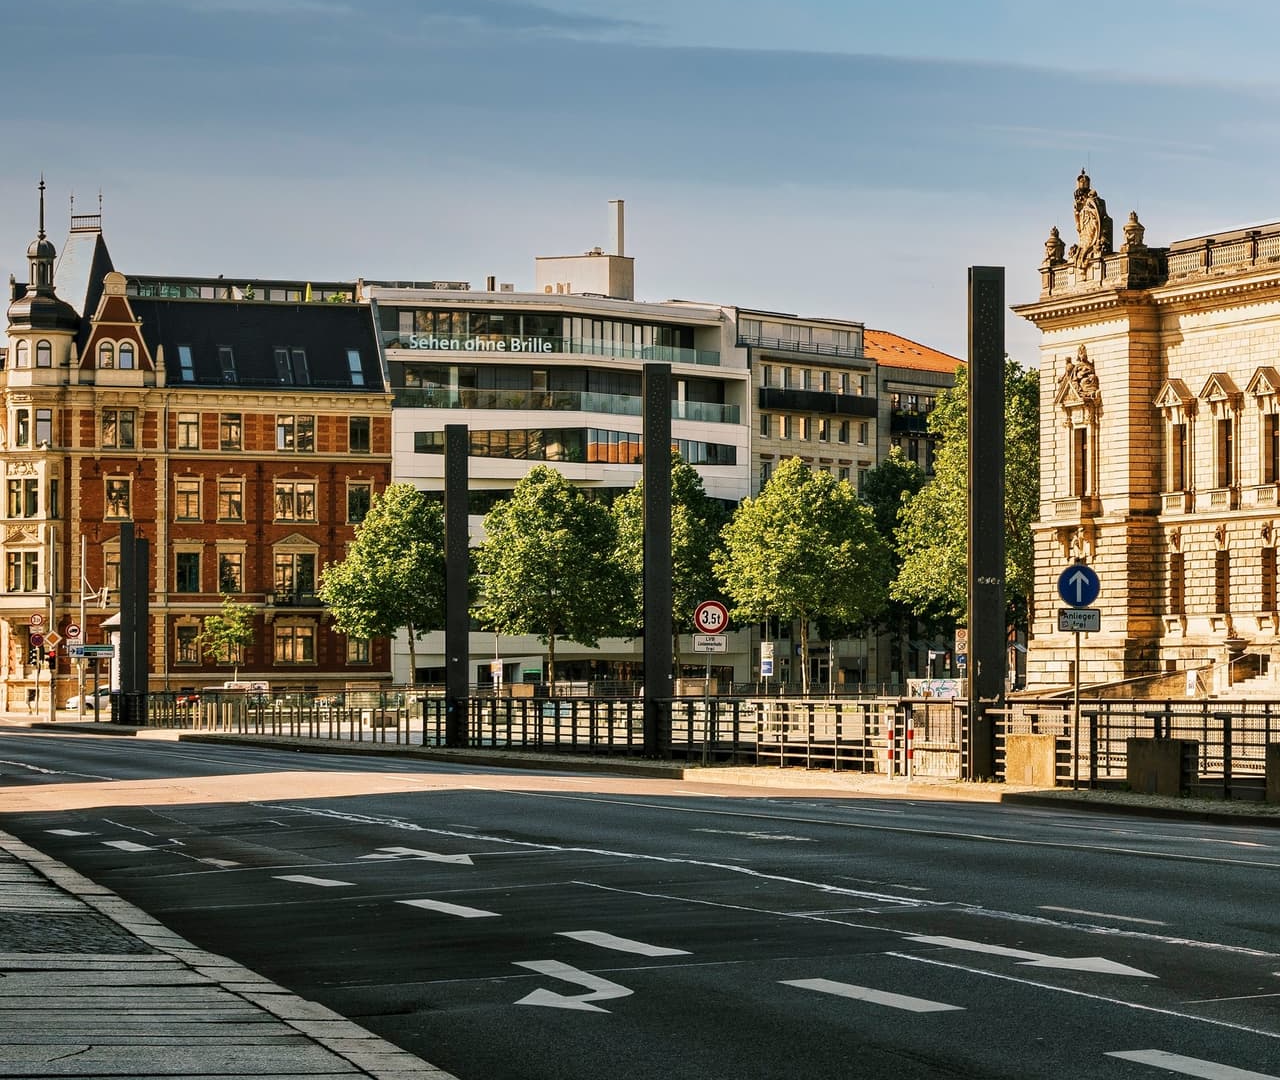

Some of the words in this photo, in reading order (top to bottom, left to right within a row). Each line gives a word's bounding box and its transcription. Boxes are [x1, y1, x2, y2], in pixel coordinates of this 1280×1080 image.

[409, 334, 460, 350] Sehen
[464, 335, 506, 352] ohne
[510, 337, 553, 353] Brille
